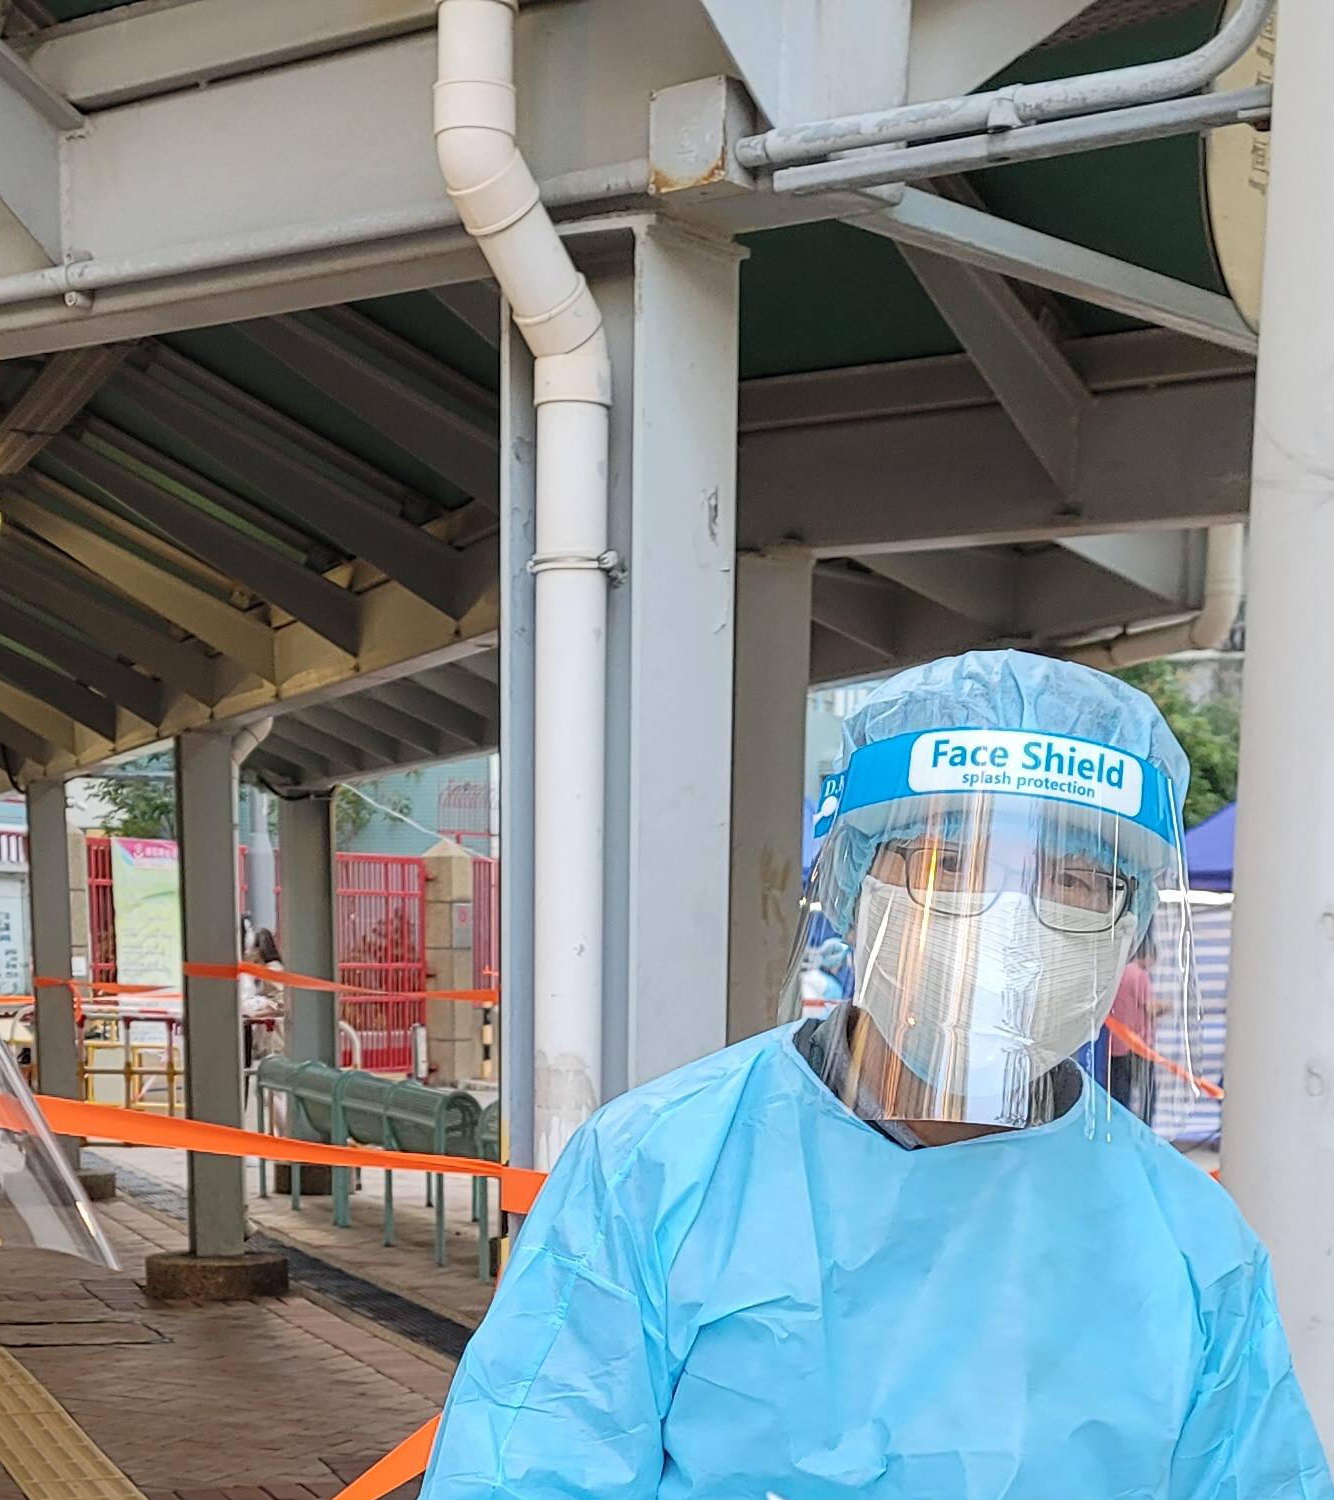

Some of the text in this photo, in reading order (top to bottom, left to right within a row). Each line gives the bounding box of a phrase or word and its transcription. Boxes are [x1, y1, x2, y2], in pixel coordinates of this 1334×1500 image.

[932, 739, 1124, 789] Face Shield
[962, 771, 1095, 798] splash protection
